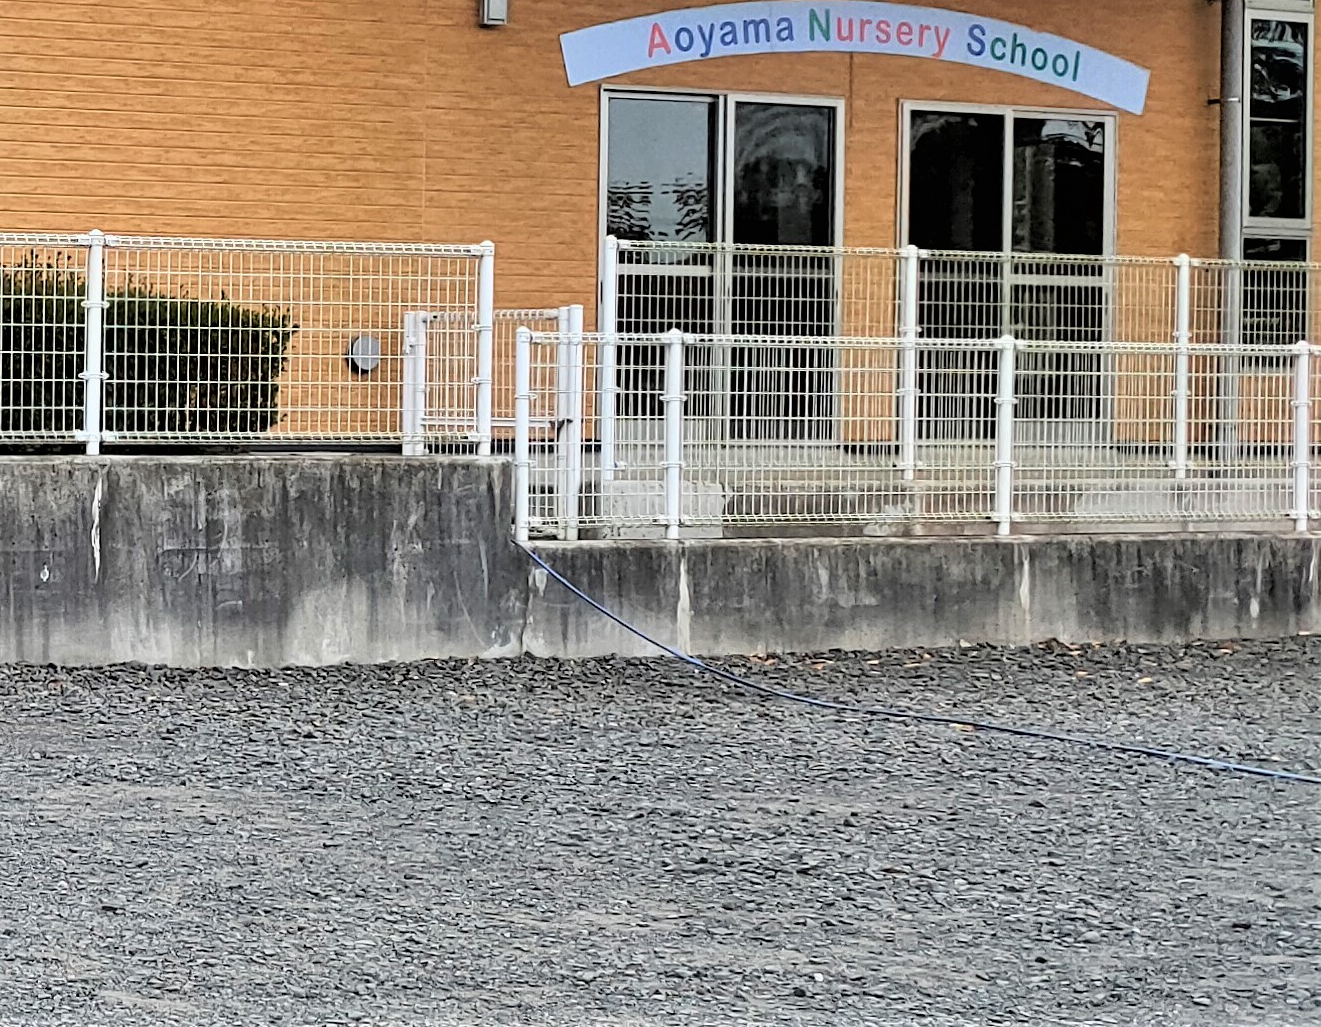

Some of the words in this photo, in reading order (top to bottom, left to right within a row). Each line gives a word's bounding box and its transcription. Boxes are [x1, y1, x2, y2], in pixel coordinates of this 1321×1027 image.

[647, 15, 795, 58] Aoyama
[808, 8, 951, 57] Nursery
[966, 24, 1081, 83] School
